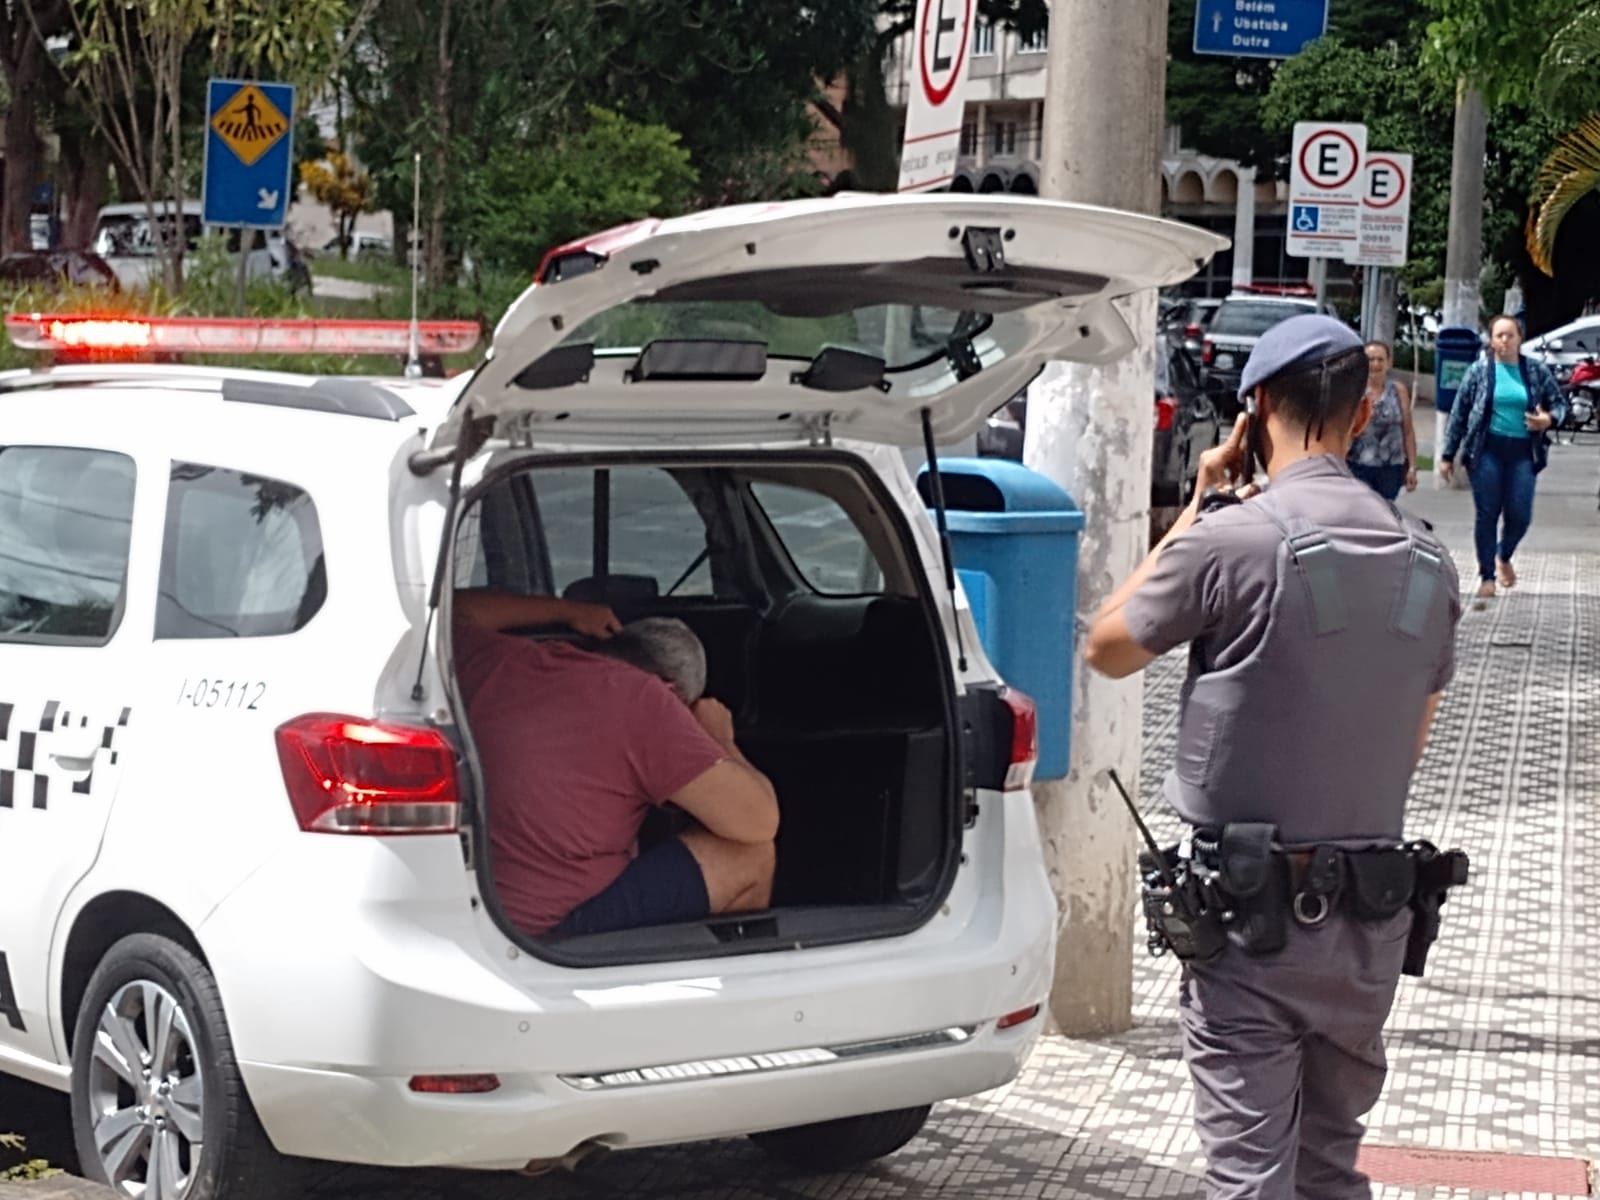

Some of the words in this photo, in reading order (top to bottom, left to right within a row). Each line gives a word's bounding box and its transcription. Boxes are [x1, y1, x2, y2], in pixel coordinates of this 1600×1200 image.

[932, 0, 956, 73] E
[1233, 16, 1288, 31] Ubatuba
[1232, 34, 1270, 48] Dutra
[1318, 143, 1340, 177] E
[1370, 169, 1390, 198] E
